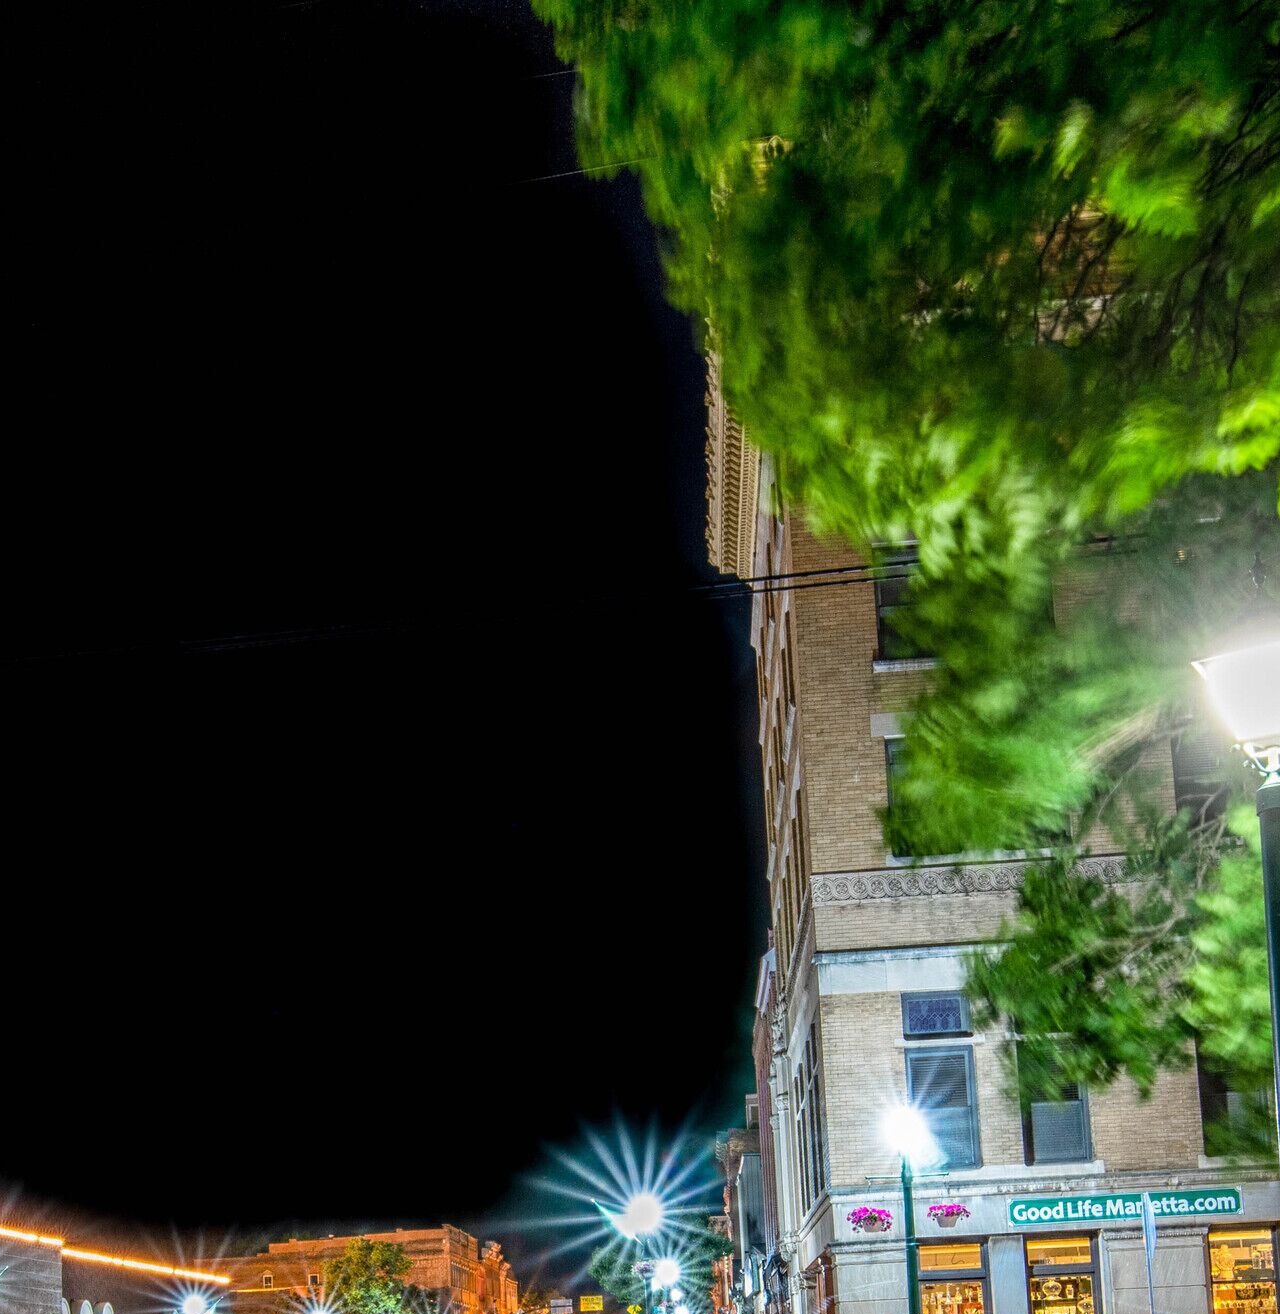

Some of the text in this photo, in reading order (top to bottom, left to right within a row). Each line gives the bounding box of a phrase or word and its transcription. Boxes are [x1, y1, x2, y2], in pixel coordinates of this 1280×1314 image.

[1013, 1195, 1237, 1222] Good Life Maretta.com
